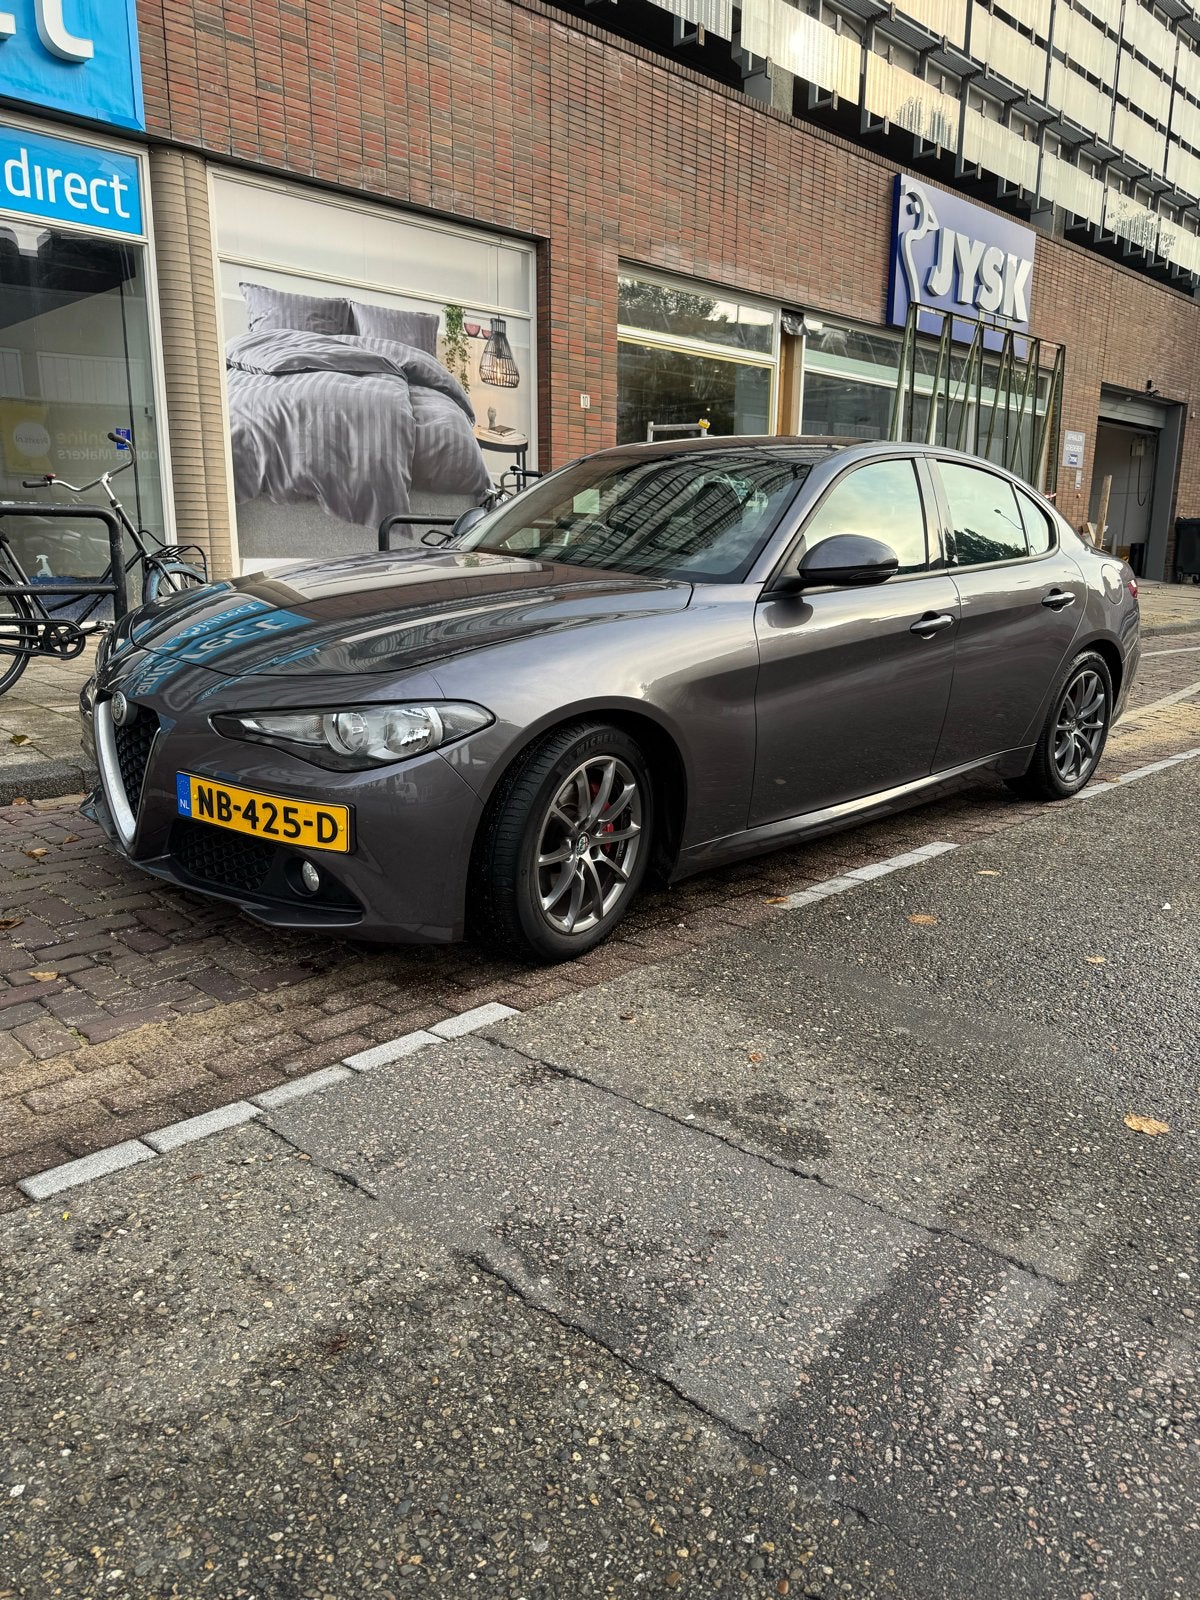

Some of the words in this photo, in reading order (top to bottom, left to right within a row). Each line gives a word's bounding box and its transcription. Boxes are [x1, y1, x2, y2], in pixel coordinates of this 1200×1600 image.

[927, 226, 1033, 323] JYSK
[576, 733, 624, 755] MICHELI
[179, 798, 190, 810] NL
[197, 785, 338, 844] NB-425-D
